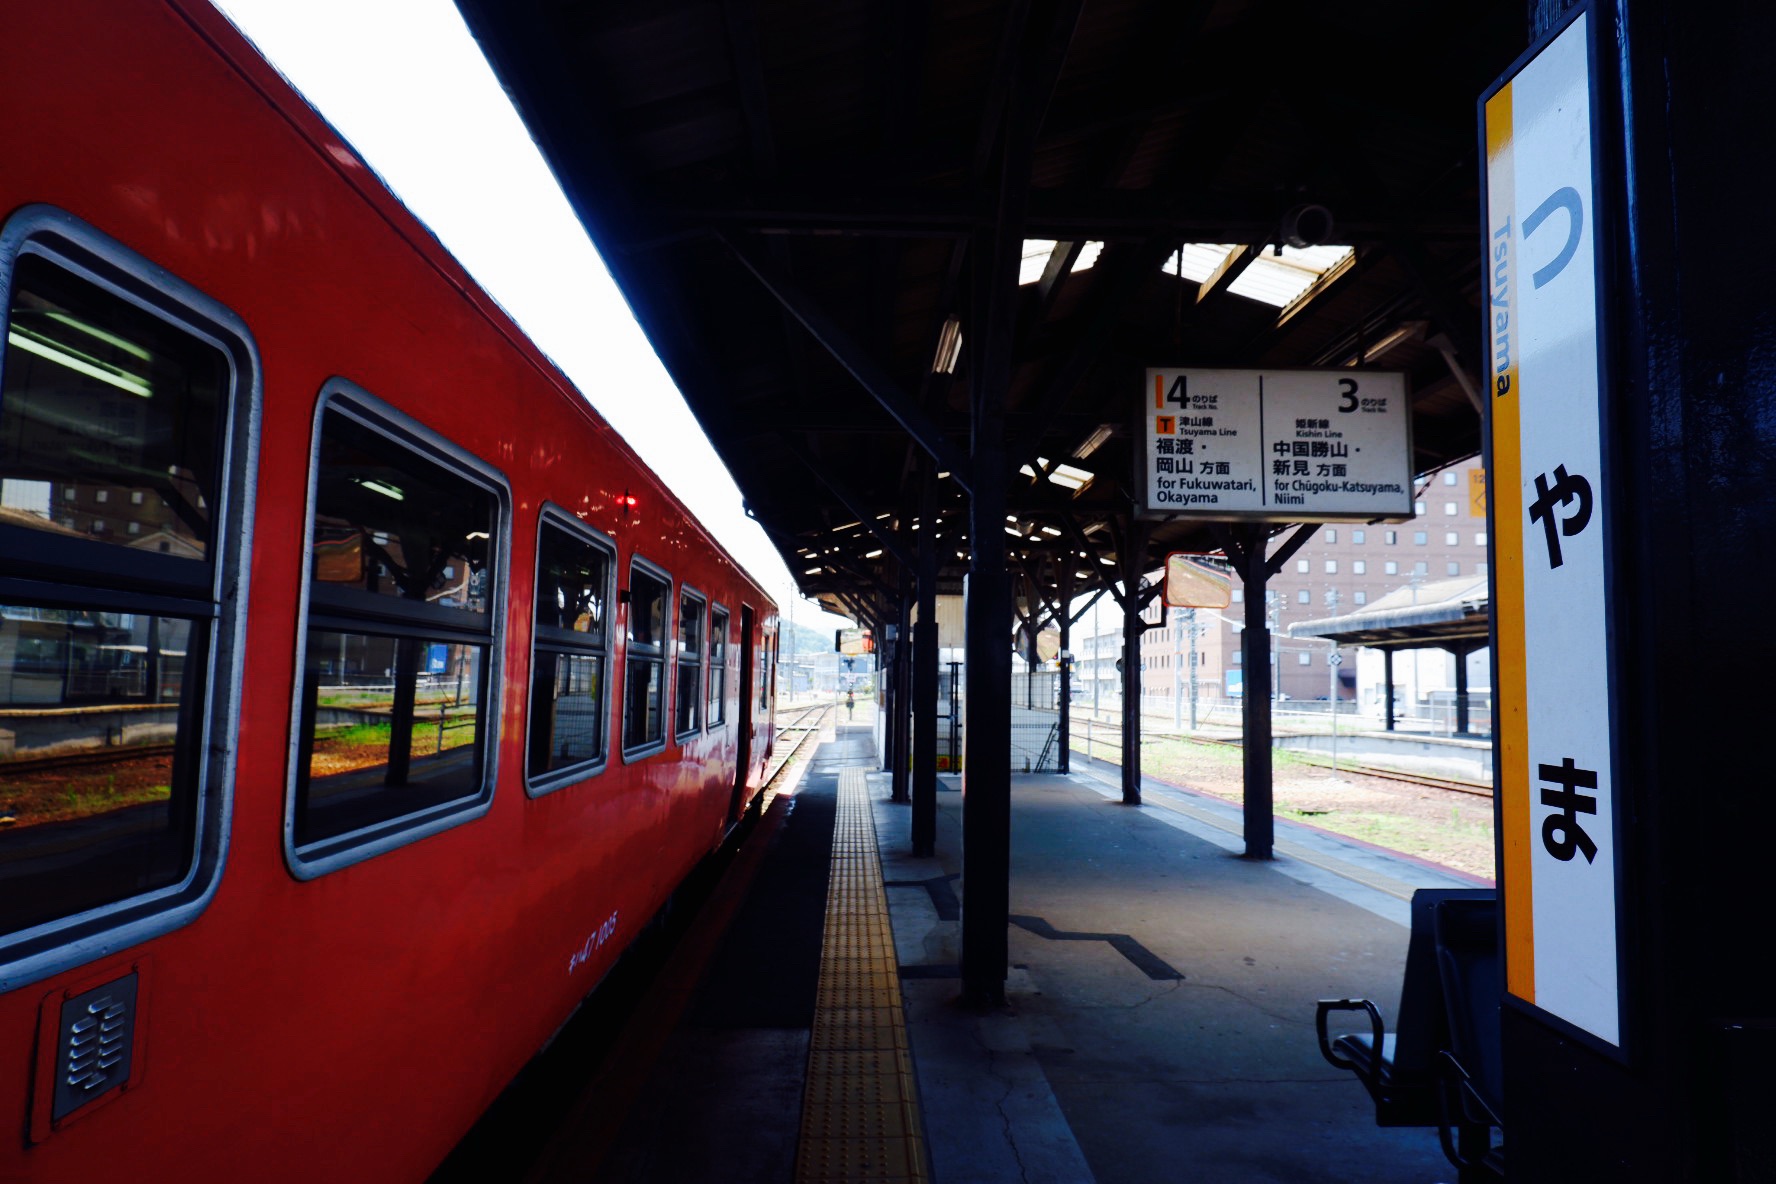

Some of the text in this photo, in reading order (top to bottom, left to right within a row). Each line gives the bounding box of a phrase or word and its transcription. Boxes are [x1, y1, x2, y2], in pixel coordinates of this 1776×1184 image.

[1489, 216, 1515, 398] Tsuyama
[1167, 375, 1218, 410] 4 のりば
[1338, 378, 1359, 414] 3
[1159, 419, 1171, 432] T
[1179, 417, 1213, 427] 津山線
[1296, 418, 1330, 429] 姫新線
[1180, 428, 1238, 437] Tsuyama Line
[1296, 429, 1343, 438] Kishin Line
[1156, 457, 1230, 475] 岡山 方面
[1273, 459, 1347, 477] 新見 方面
[1157, 476, 1257, 492] for Fukuwatari,
[1274, 478, 1404, 496] for Chūgoku-Katsuyama,
[1157, 490, 1218, 506] Okayama
[1274, 492, 1305, 505] Niimi
[1523, 186, 1599, 865] つやま
